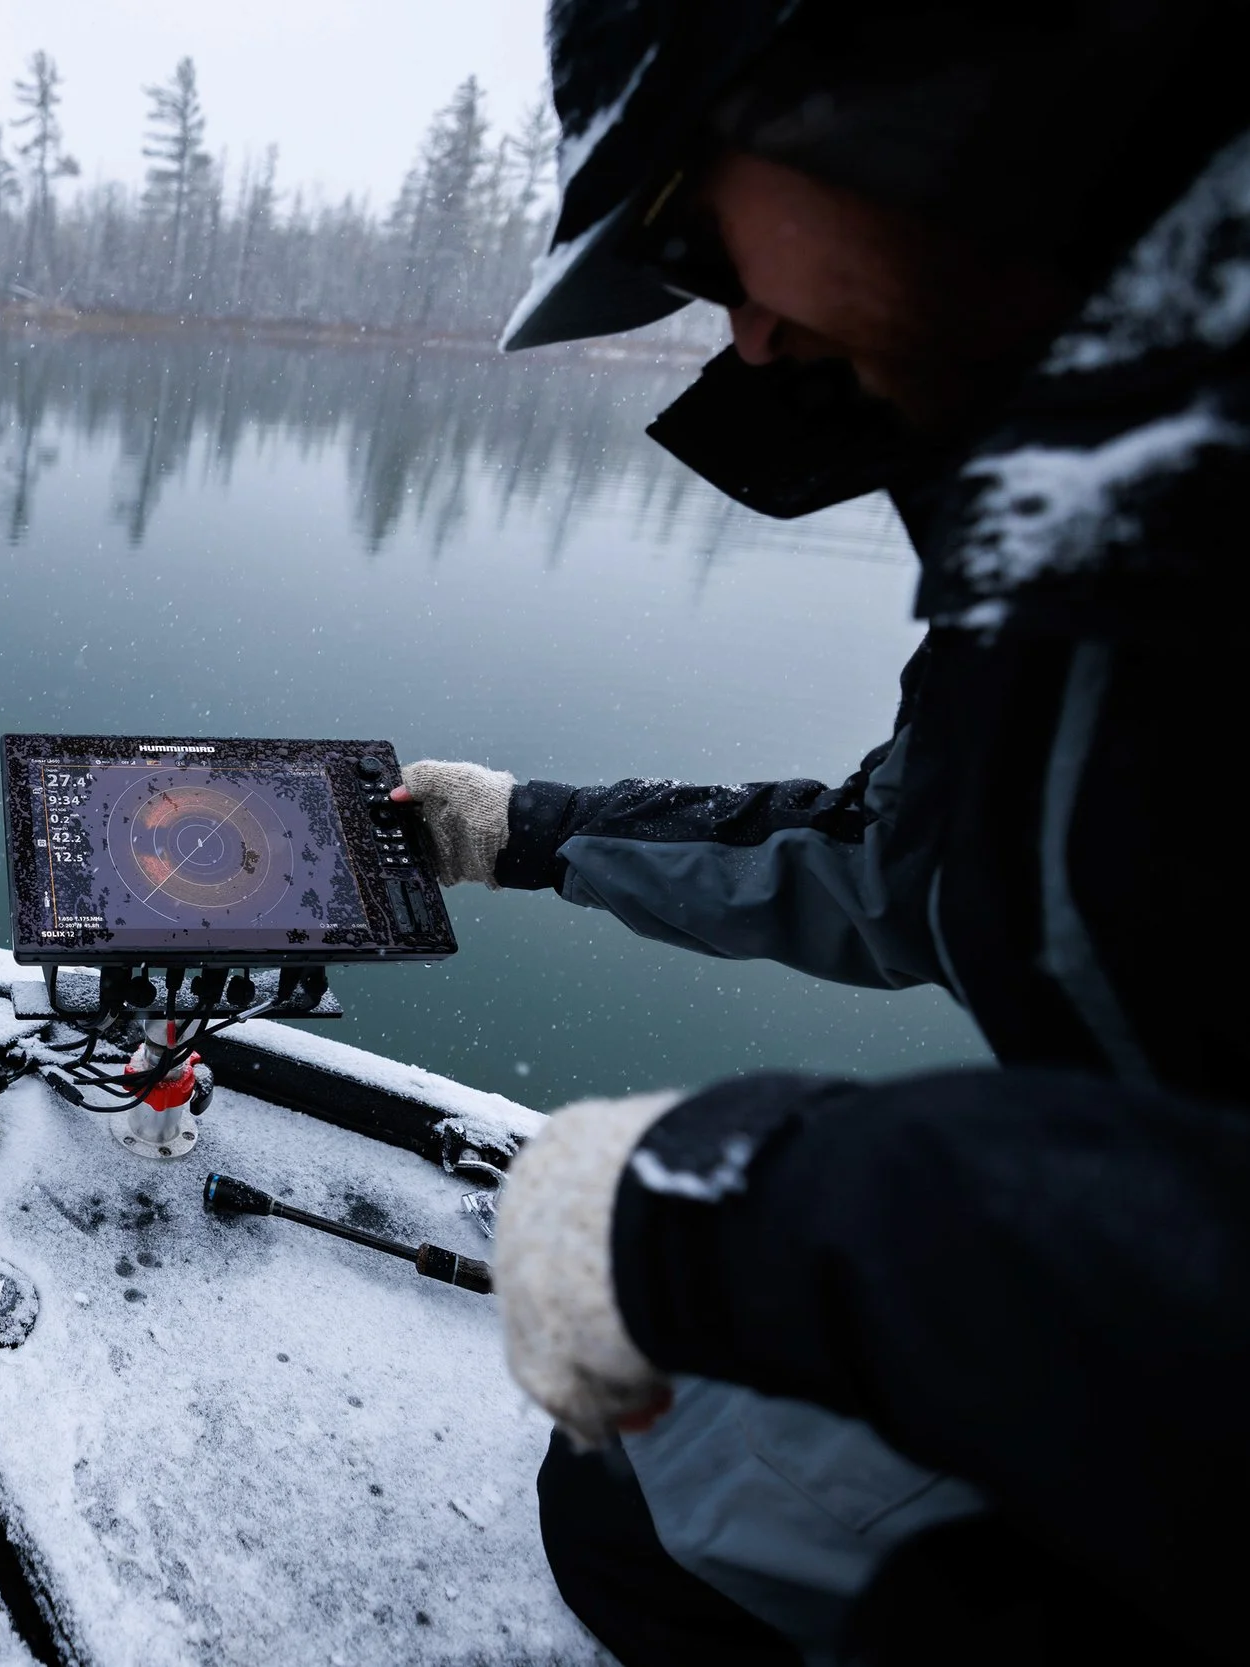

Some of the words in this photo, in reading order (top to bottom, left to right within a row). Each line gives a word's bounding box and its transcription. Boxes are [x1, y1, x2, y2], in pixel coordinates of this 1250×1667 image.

[139, 745, 215, 753] HUMMINBIRD
[48, 774, 86, 787] 27.4
[49, 796, 80, 805] 9:34
[50, 814, 70, 824] 0.2
[52, 832, 81, 843] 42.2
[54, 852, 83, 862] 12.5
[41, 930, 65, 938] SOLIX
[67, 930, 75, 938] 12
